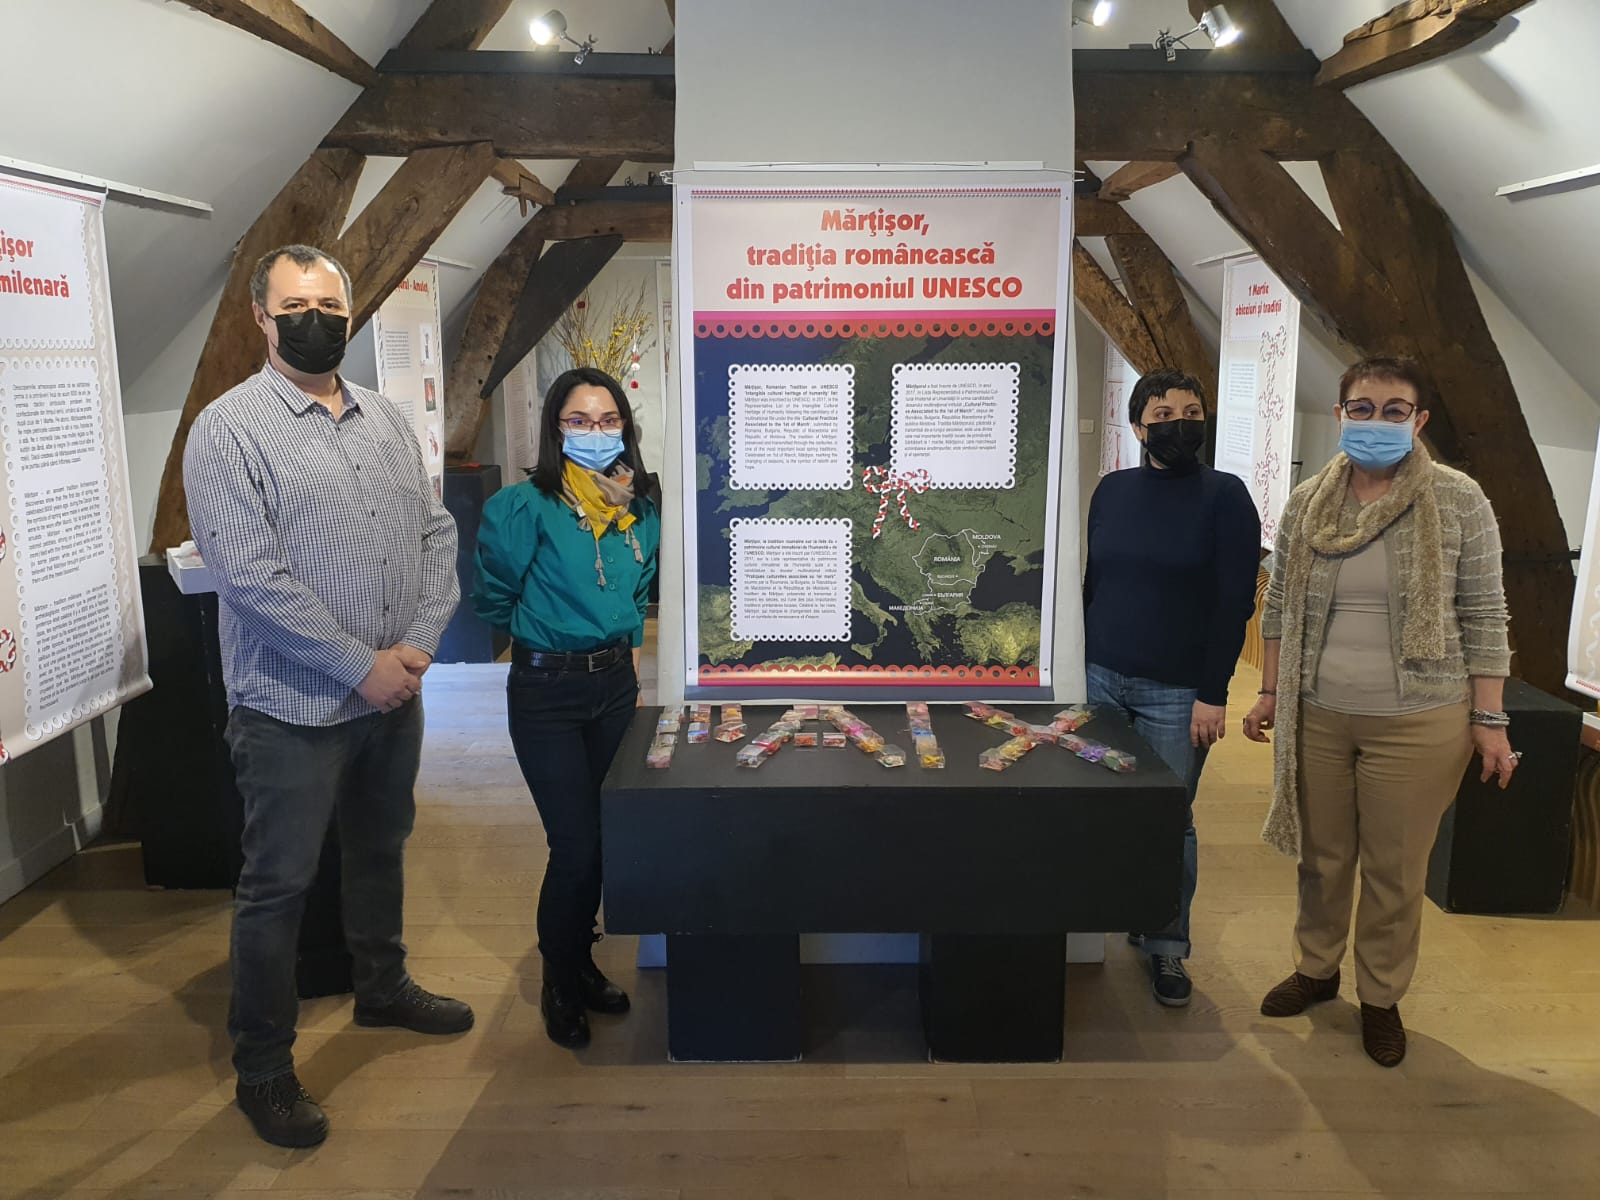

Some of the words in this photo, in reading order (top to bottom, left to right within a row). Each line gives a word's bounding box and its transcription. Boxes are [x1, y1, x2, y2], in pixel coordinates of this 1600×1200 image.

[845, 242, 995, 266] românească
[0, 269, 69, 298] milenară
[727, 277, 764, 300] din
[772, 277, 914, 304] patrimoniul
[922, 277, 1022, 298] UNESCO
[1249, 285, 1252, 296] 1
